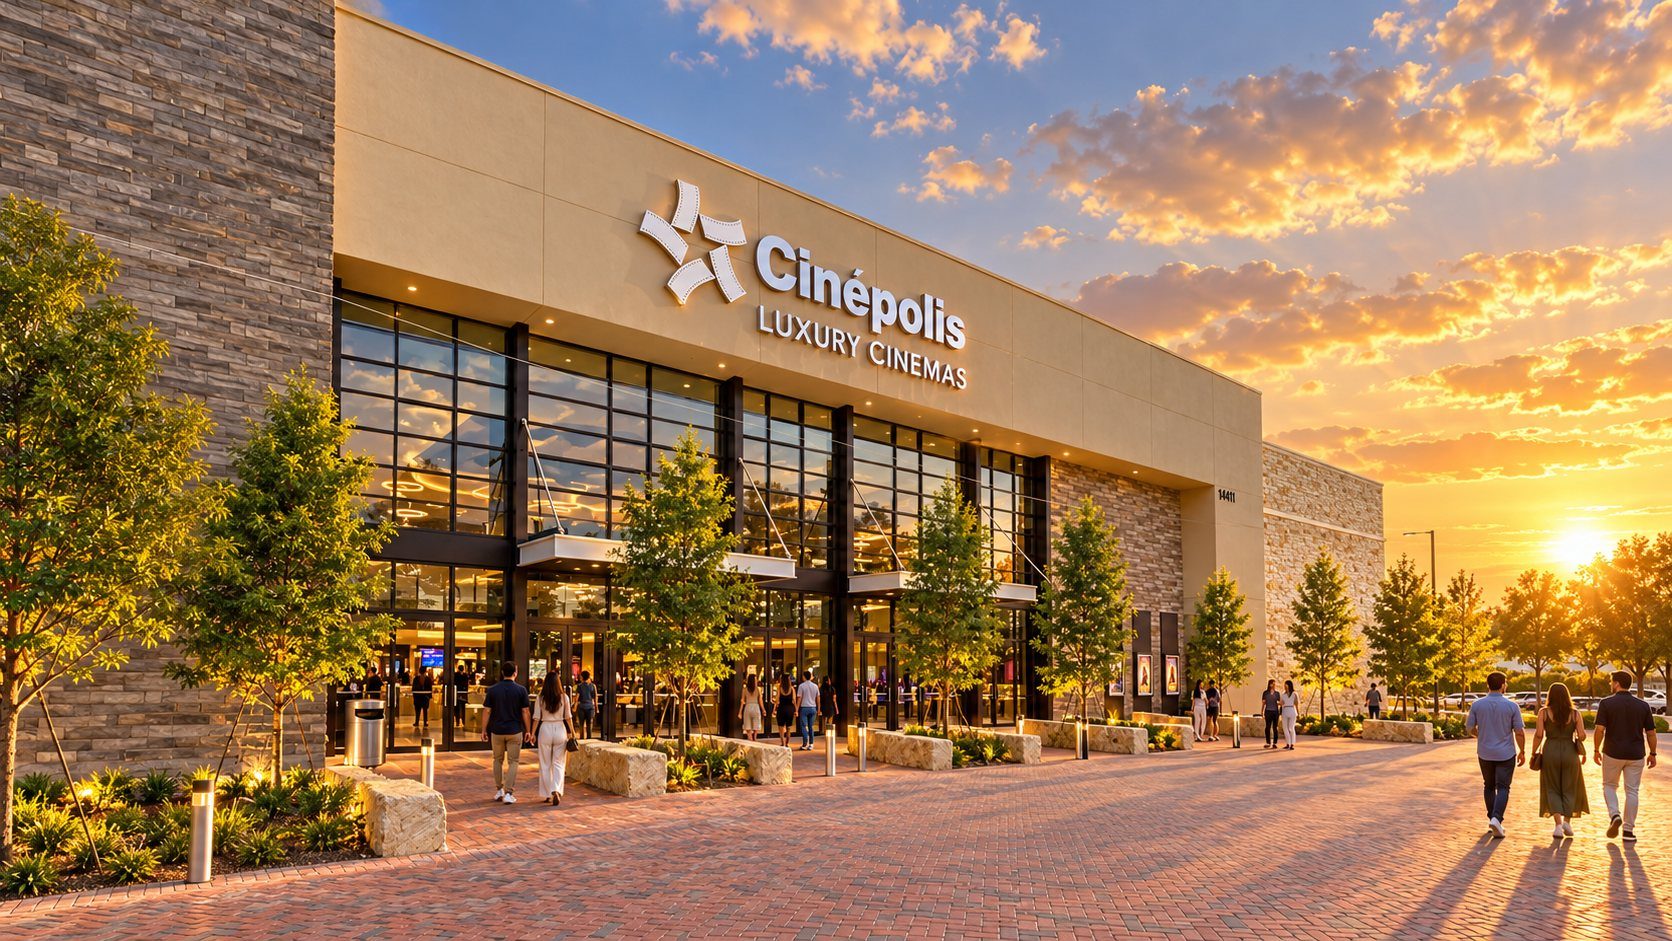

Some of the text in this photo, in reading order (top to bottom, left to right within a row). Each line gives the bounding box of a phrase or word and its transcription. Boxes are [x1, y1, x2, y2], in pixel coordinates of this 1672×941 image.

[756, 235, 966, 350] Cinépolis
[758, 305, 967, 389] LUXURY CINEMAS
[1218, 489, 1235, 503] 14411
